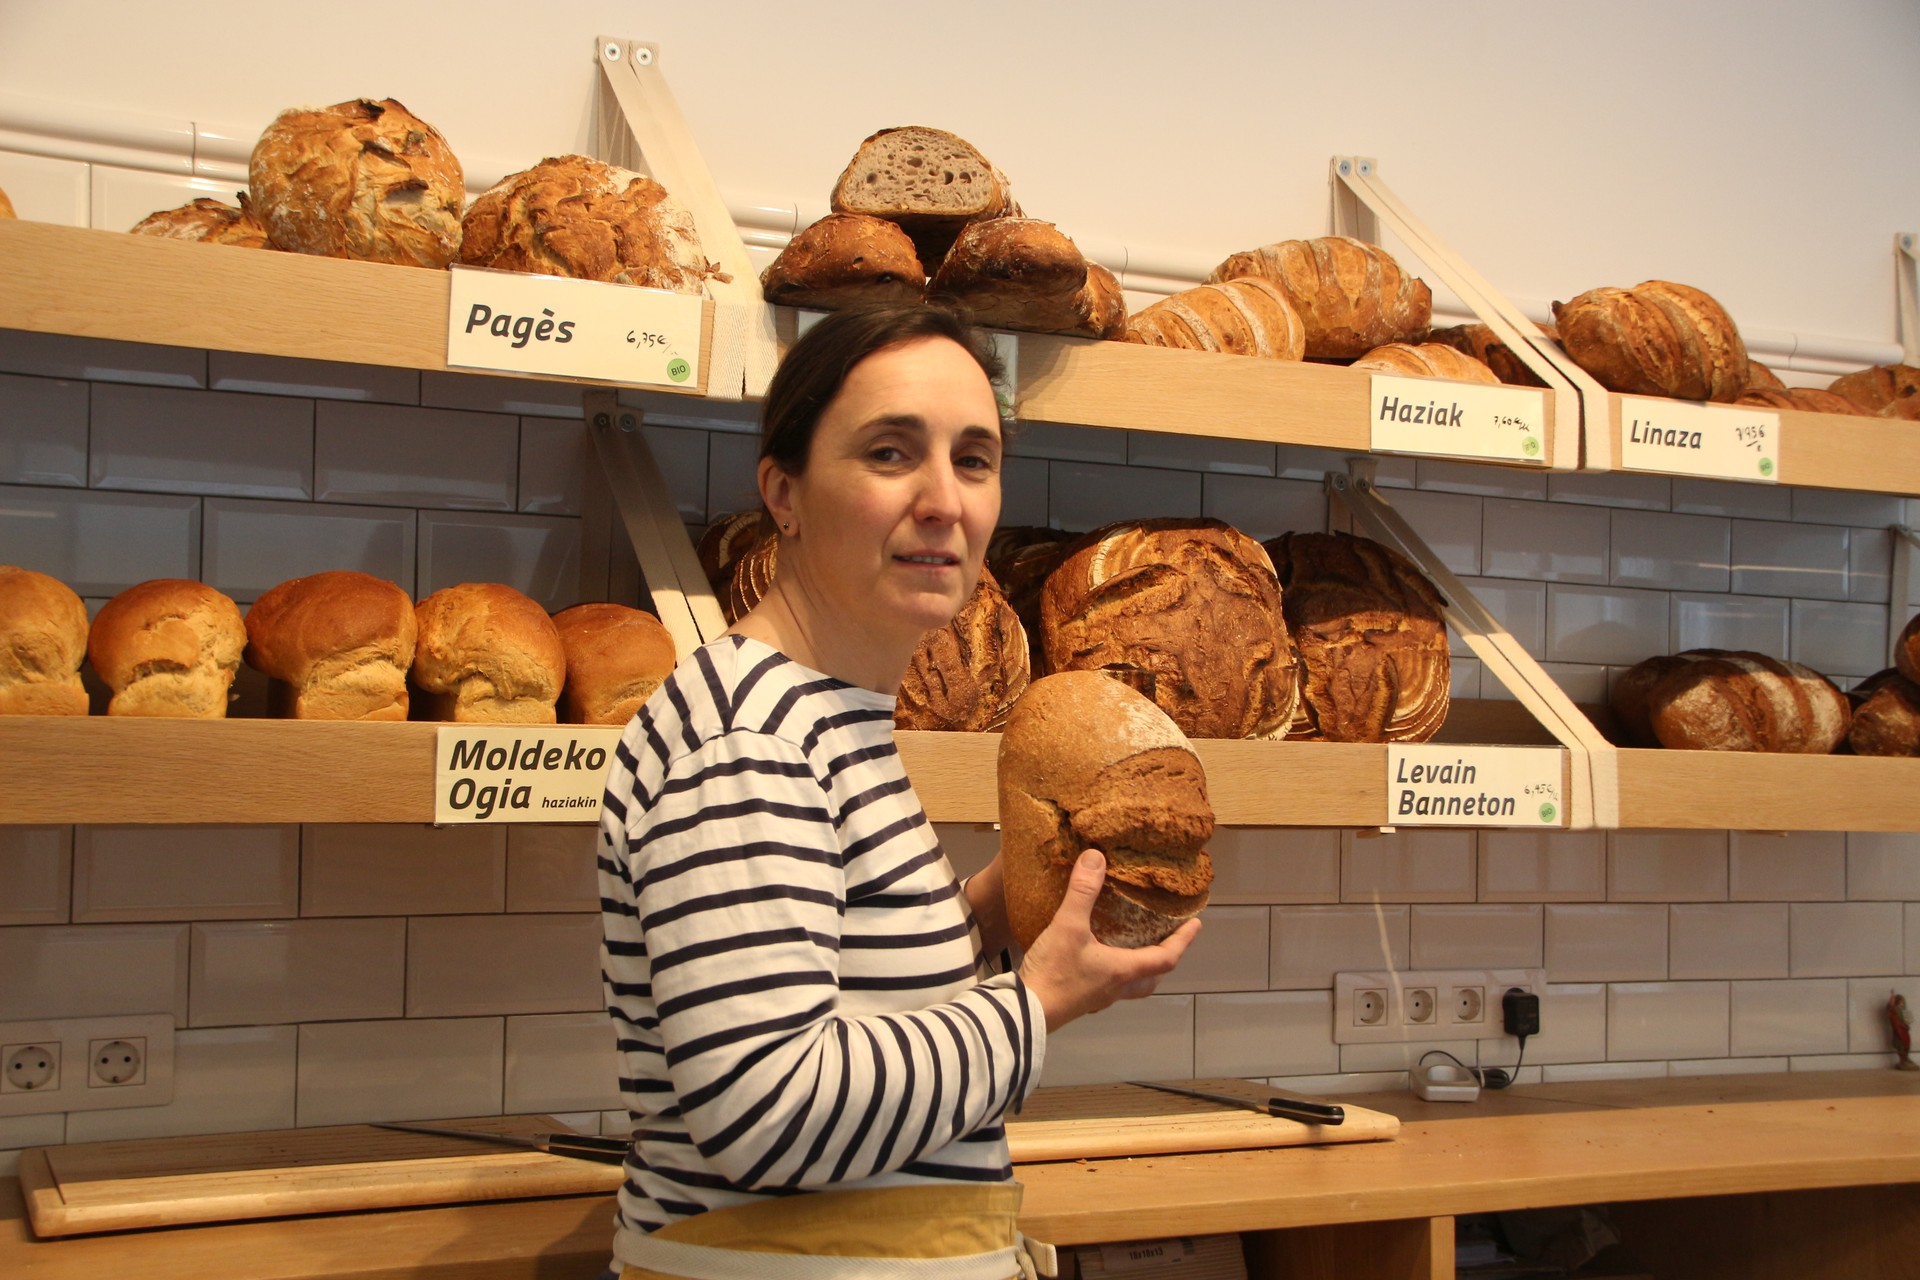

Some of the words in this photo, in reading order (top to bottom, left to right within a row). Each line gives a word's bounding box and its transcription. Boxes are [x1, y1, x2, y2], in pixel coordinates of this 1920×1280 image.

[465, 304, 576, 348] Pagès
[671, 365, 686, 376] BIO
[1379, 396, 1464, 427] Haziak
[1630, 419, 1702, 450] Linaza
[449, 739, 607, 771] Moldeko
[1396, 758, 1477, 784] Levain
[449, 777, 533, 820] Ogia
[541, 796, 597, 809] haziakin
[1397, 789, 1515, 816] Banneton
[1541, 807, 1553, 818] BIO
